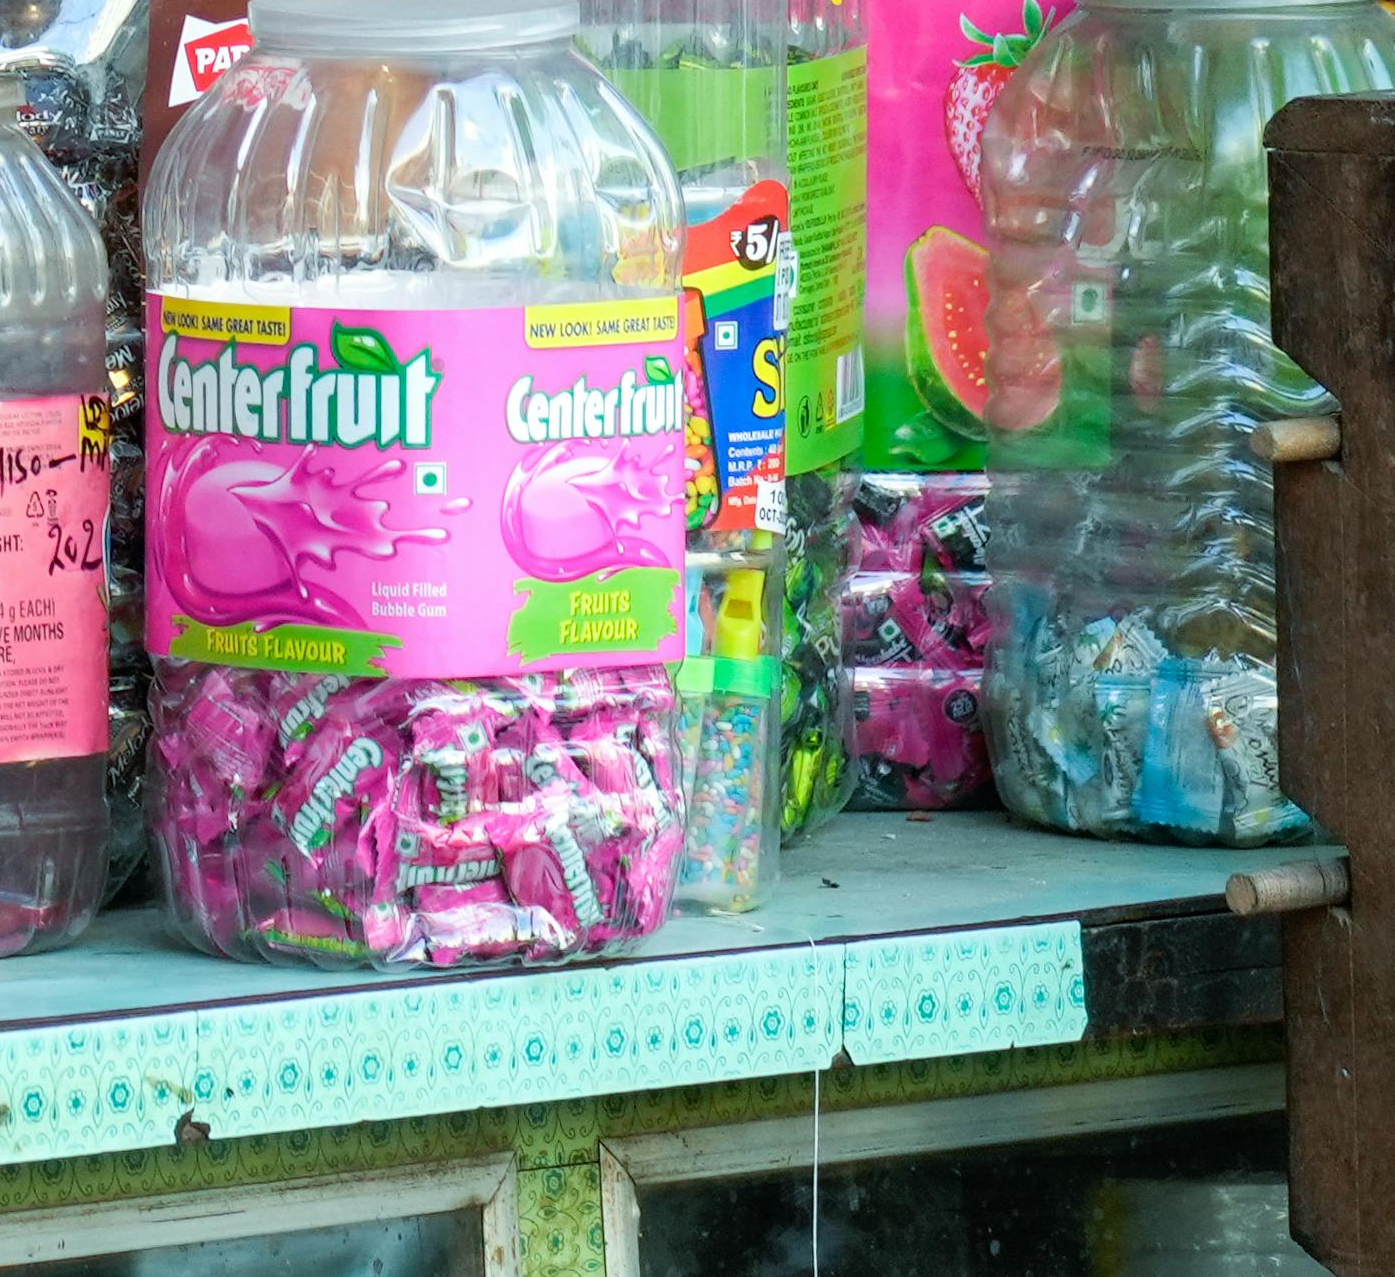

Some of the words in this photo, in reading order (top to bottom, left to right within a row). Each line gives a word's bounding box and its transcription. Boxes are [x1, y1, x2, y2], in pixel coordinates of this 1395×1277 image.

[16, 109, 64, 124] lody
[163, 311, 176, 326] NEW
[177, 313, 199, 329] LOOK!
[201, 316, 223, 332] SAME
[225, 318, 254, 334] GREAT
[256, 320, 286, 337] TASTE!
[530, 323, 556, 338] NEW
[560, 321, 593, 337] LOOK!
[596, 319, 620, 335] SAME
[623, 317, 651, 333] GREAT
[371, 582, 408, 601] Liquid
[412, 582, 447, 599] Filled
[569, 590, 630, 615] FRUITS
[9, 605, 16, 623] g
[19, 598, 56, 618] EACH)
[371, 601, 413, 617] Bubble
[418, 602, 447, 618] Gum
[13, 622, 65, 642] MONTHS
[559, 618, 639, 644] FLAVOUR
[206, 629, 260, 657] FRUITS
[263, 633, 346, 665] FLAVOUR
